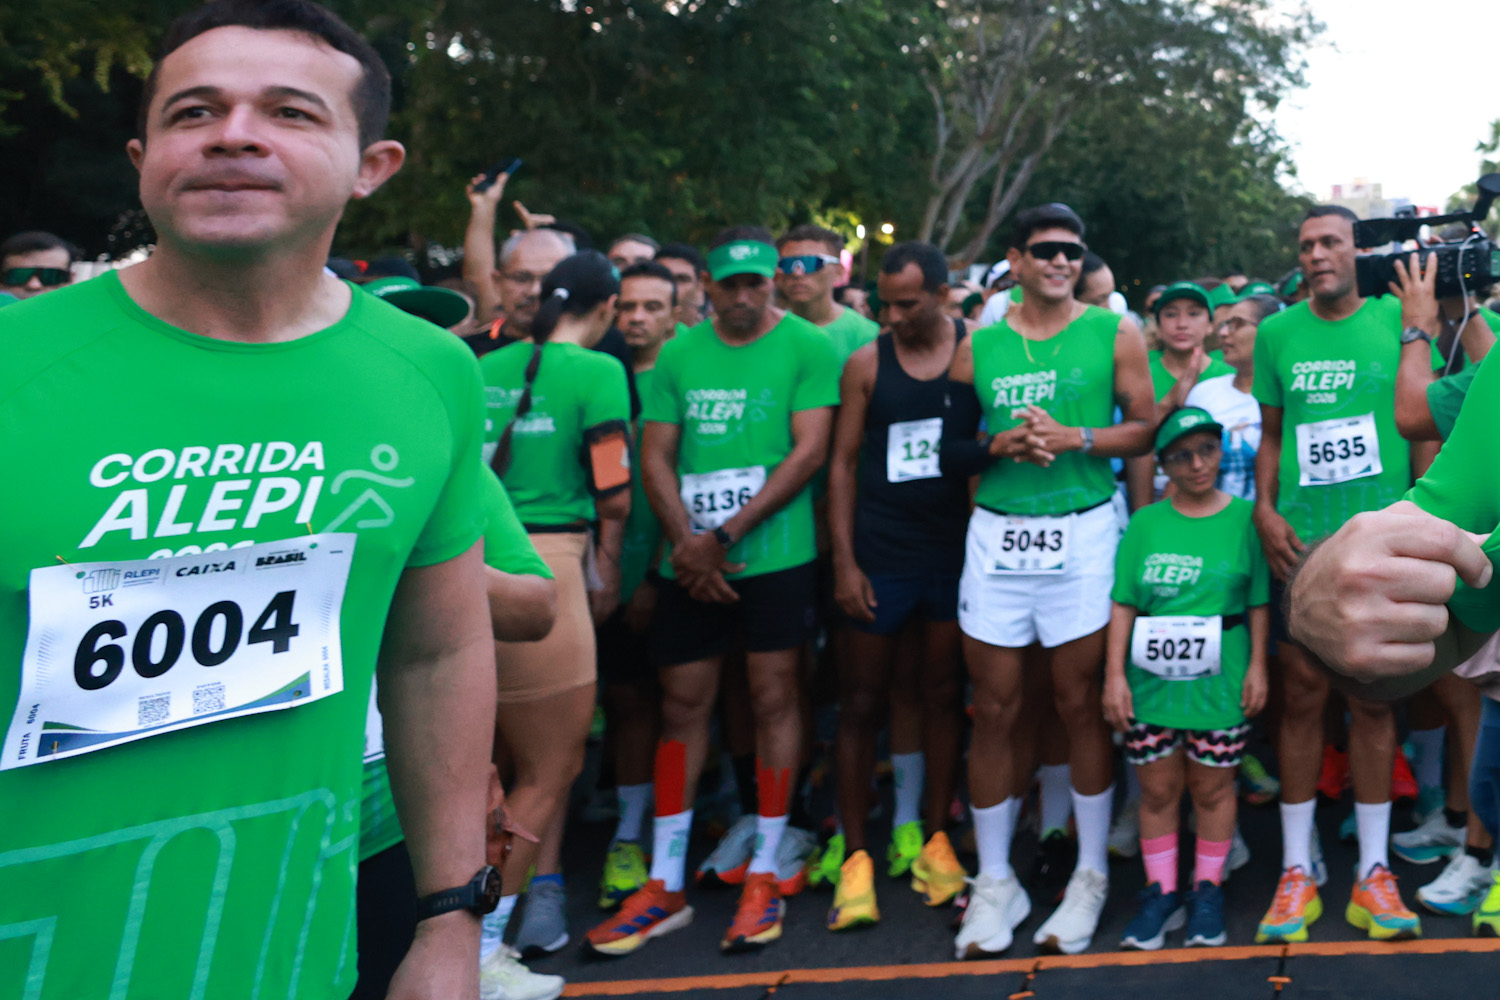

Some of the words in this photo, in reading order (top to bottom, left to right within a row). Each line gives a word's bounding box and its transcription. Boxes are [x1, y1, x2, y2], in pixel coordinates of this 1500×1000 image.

[1291, 359, 1356, 374] CORRIDA
[991, 369, 1057, 391] CORRIDA
[1290, 372, 1356, 392] ALEPI
[993, 382, 1057, 408] ALEPI
[1305, 392, 1338, 404] 2026
[684, 401, 746, 421] ALEPI
[1309, 435, 1367, 465] 5635
[89, 441, 326, 488] CORRIDA
[693, 486, 753, 513] 5136
[78, 475, 325, 549] ALEPI
[1002, 529, 1064, 552] 5043
[123, 568, 161, 580] ALEPI
[175, 561, 237, 578] CAIXA
[255, 551, 308, 567] BRASIL
[1142, 565, 1202, 586] ALEPI
[89, 593, 114, 610] 5K
[73, 589, 300, 691] 6004
[1146, 638, 1207, 661] 5027
[17, 732, 31, 761] FRUTA
[26, 703, 40, 725] 6004
